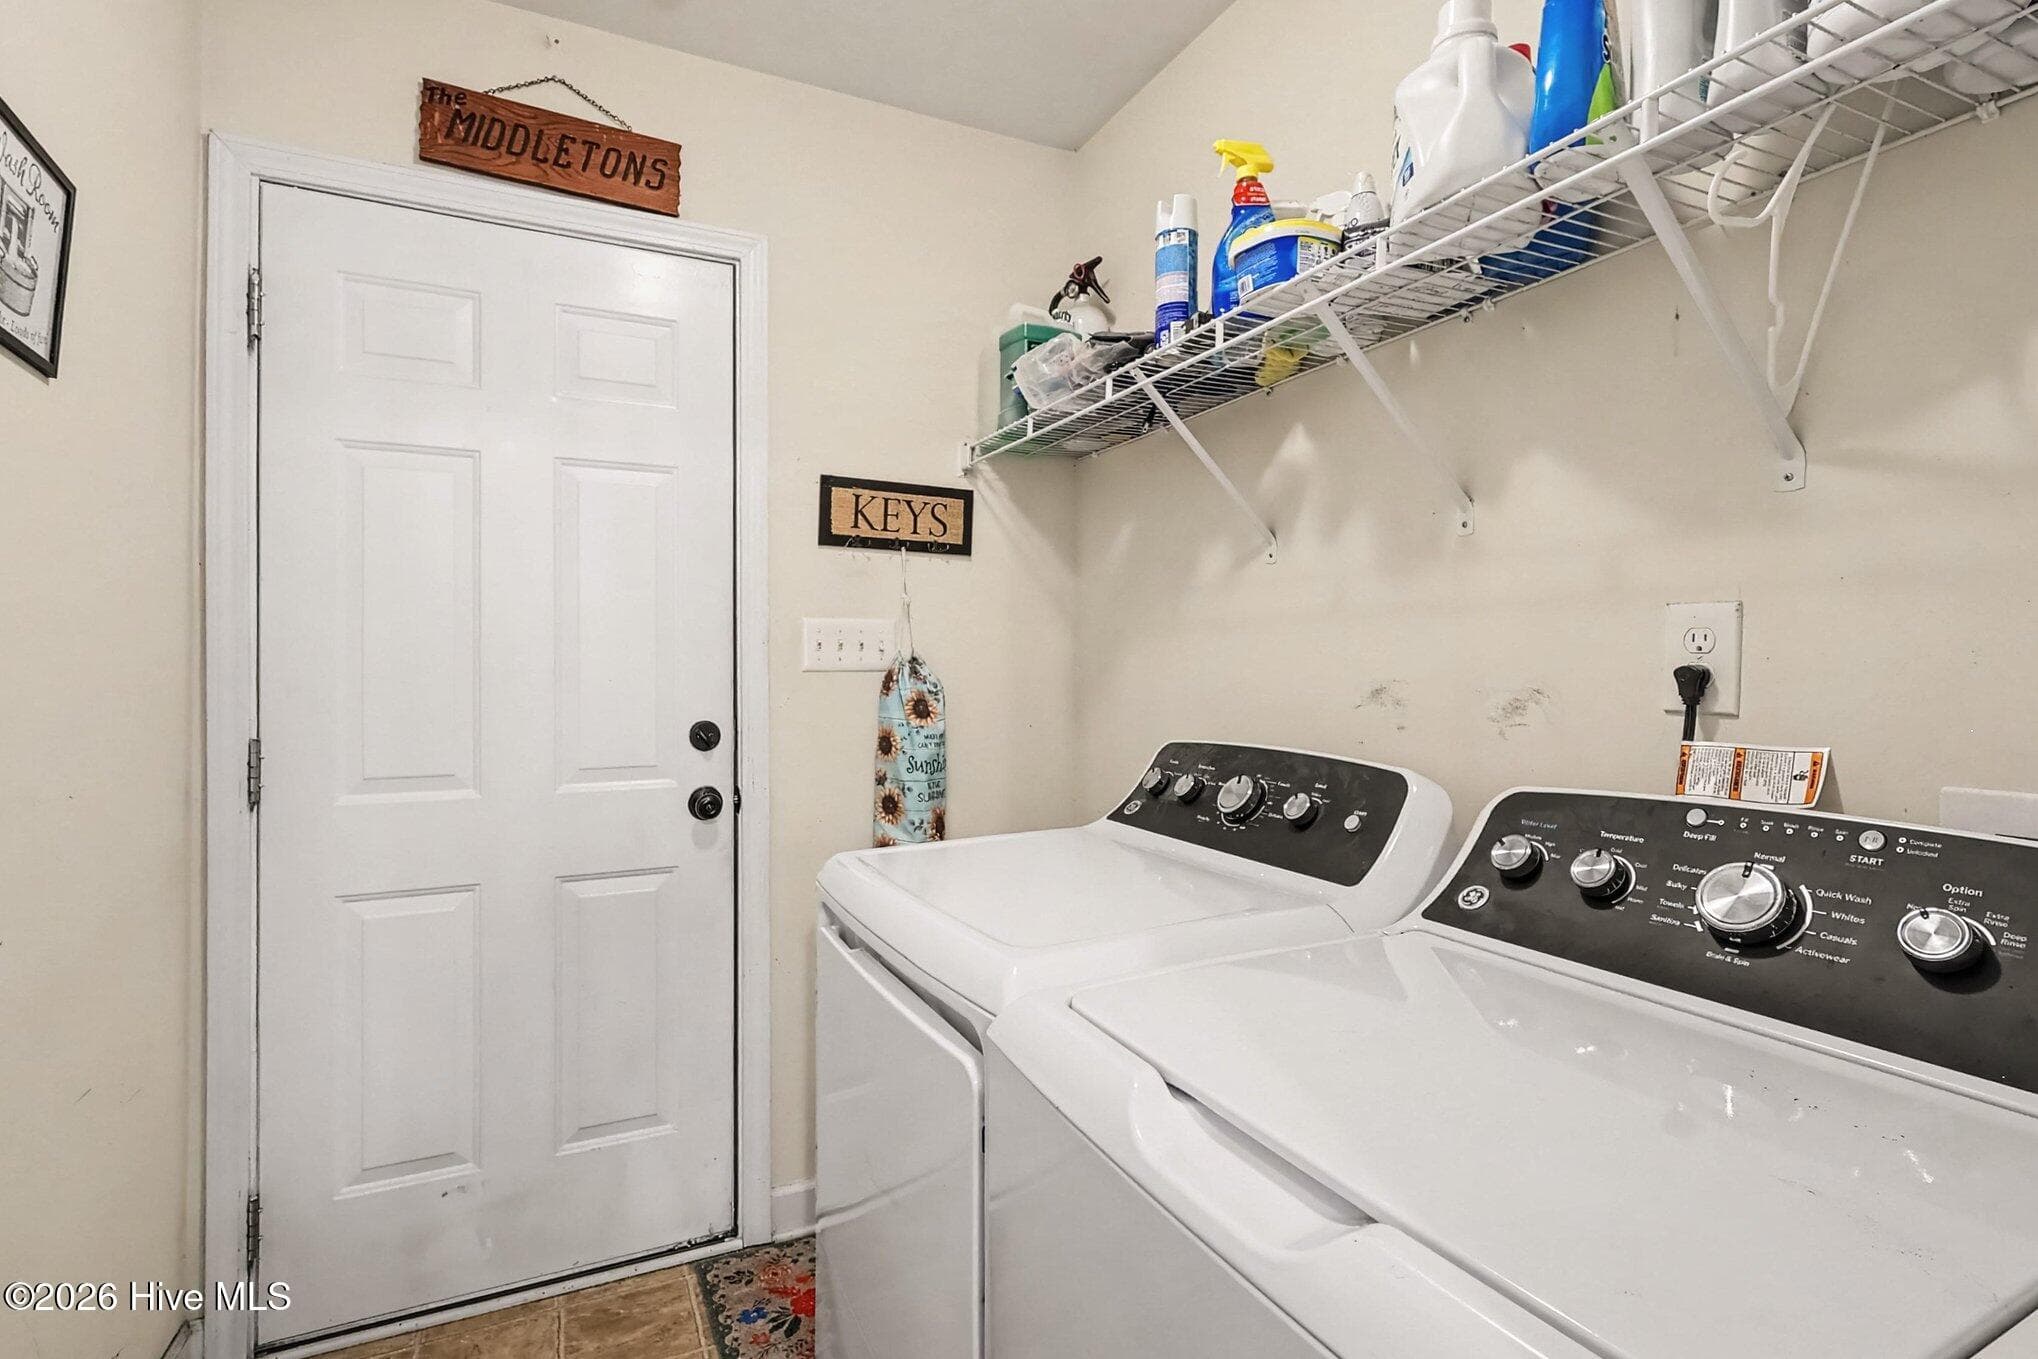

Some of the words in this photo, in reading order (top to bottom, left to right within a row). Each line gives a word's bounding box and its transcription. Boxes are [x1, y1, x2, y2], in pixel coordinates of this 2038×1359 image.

[425, 86, 468, 106] The
[444, 108, 669, 190] MIDDLETONS
[26, 163, 60, 233] Room
[851, 493, 949, 538] KEYS
[907, 753, 946, 775] Sunshi
[1600, 831, 1645, 843] Temperature
[1683, 831, 1703, 841] Deep
[1704, 834, 1717, 842] Fill
[1753, 852, 1786, 863] Normal
[1849, 854, 1884, 866] START
[1942, 883, 1983, 897] Option
[1815, 888, 1843, 900] Quick
[1845, 893, 1872, 905] Wash
[1948, 897, 1971, 907] Extra
[1659, 898, 1685, 909] Towels
[1948, 904, 1967, 913] Spin
[1831, 911, 1866, 925] Whites
[1986, 911, 2010, 921] Extra
[1983, 918, 2008, 928] Rinse
[1820, 931, 1858, 946] Casuals
[2003, 931, 2028, 942] Deep
[2000, 938, 2026, 949] Rinse
[1794, 946, 1851, 964] Activewear
[1733, 957, 1750, 966] Spin
